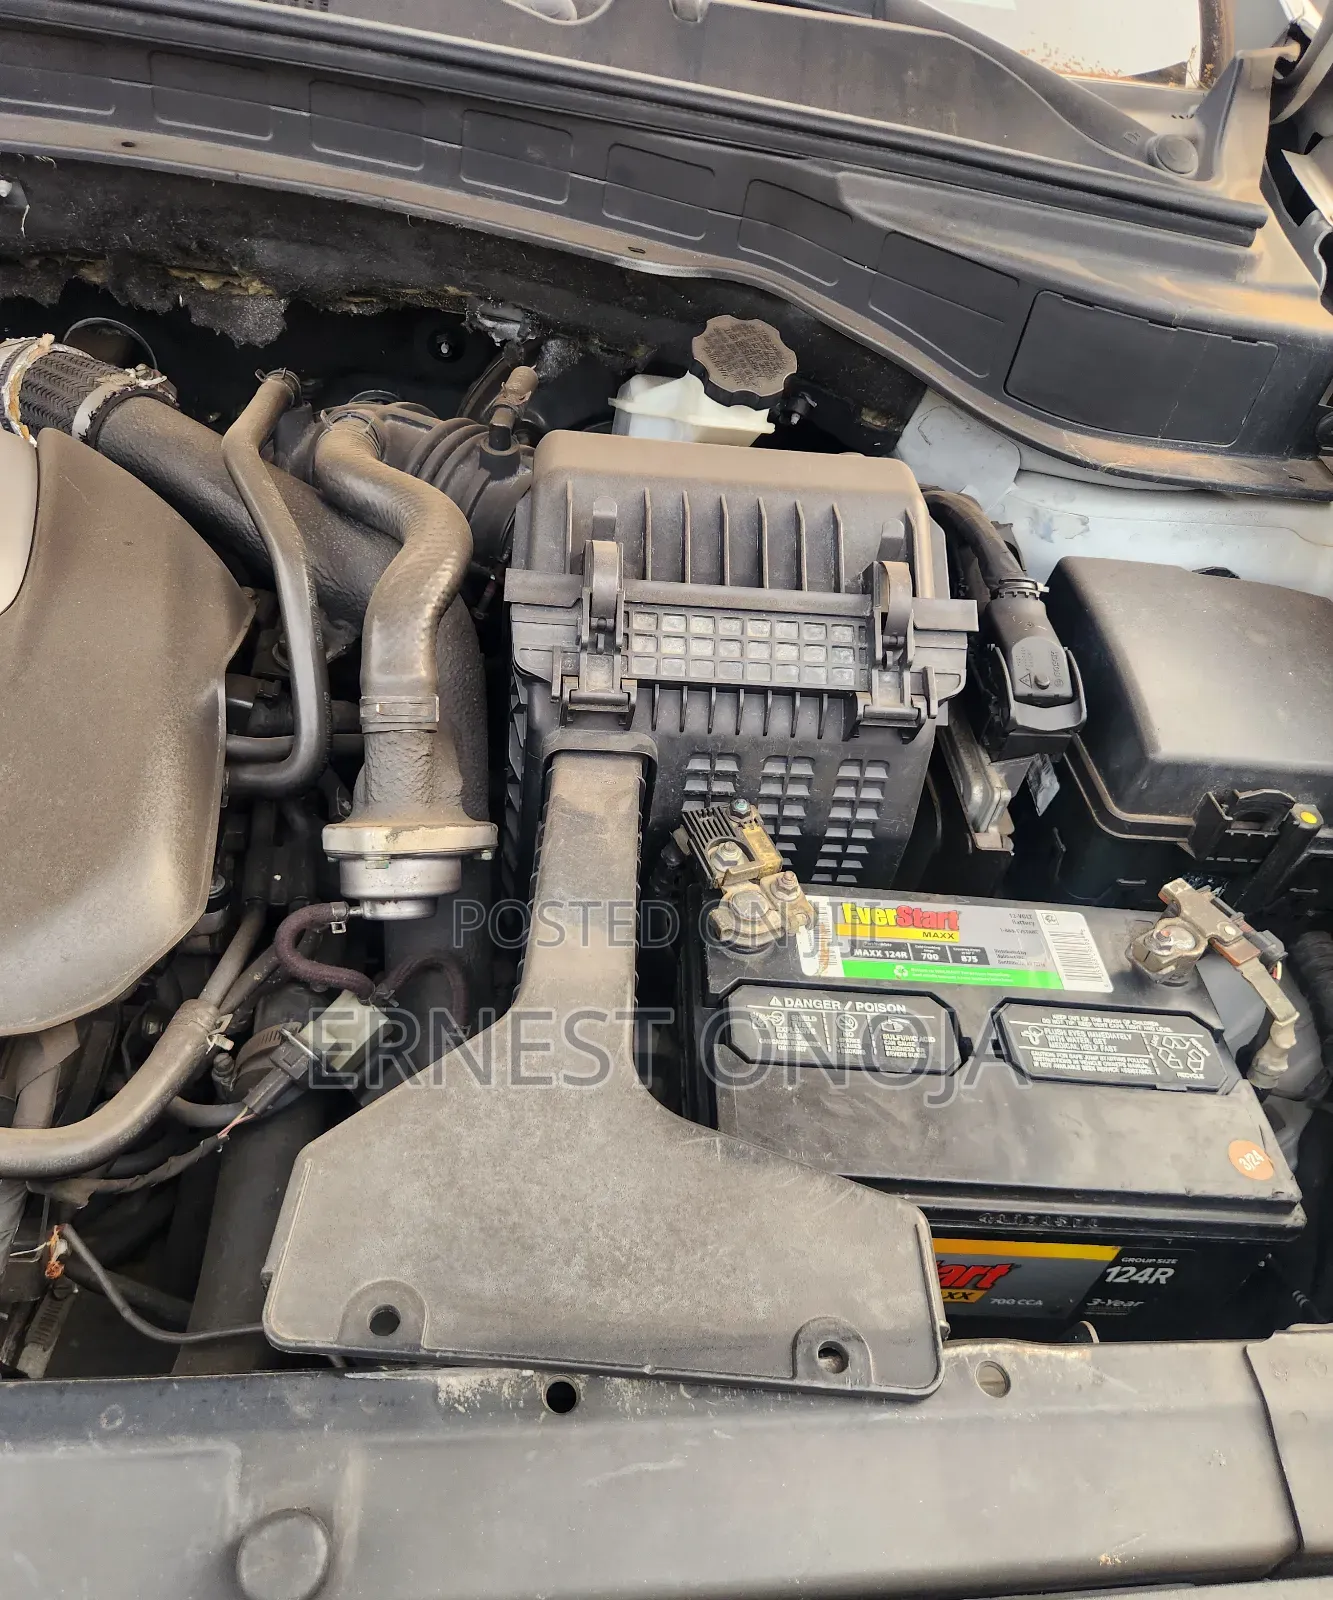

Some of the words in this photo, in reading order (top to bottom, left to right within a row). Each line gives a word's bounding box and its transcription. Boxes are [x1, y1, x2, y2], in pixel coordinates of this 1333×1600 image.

[841, 902, 959, 930] EverStart
[922, 931, 955, 940] MAXX
[854, 949, 883, 958] MAXX
[885, 950, 908, 959] 124R
[921, 952, 939, 961] 700
[961, 955, 978, 963] 875
[783, 997, 841, 1010] DANGER
[855, 1001, 906, 1014] POISON
[1043, 1027, 1068, 1036] FLUSH
[1068, 1029, 1086, 1037] EYES
[1087, 1030, 1132, 1041] IMMEDIATELY
[1047, 1034, 1065, 1043] WITH
[1092, 1037, 1107, 1046] GET
[1049, 1042, 1080, 1050] MEDICAL
[1080, 1043, 1098, 1052] HELP
[1099, 1044, 1117, 1053] FAST
[1238, 1149, 1265, 1171] 3/24
[1105, 1265, 1175, 1284] 124R
[1086, 1298, 1145, 1307] 3-Year
